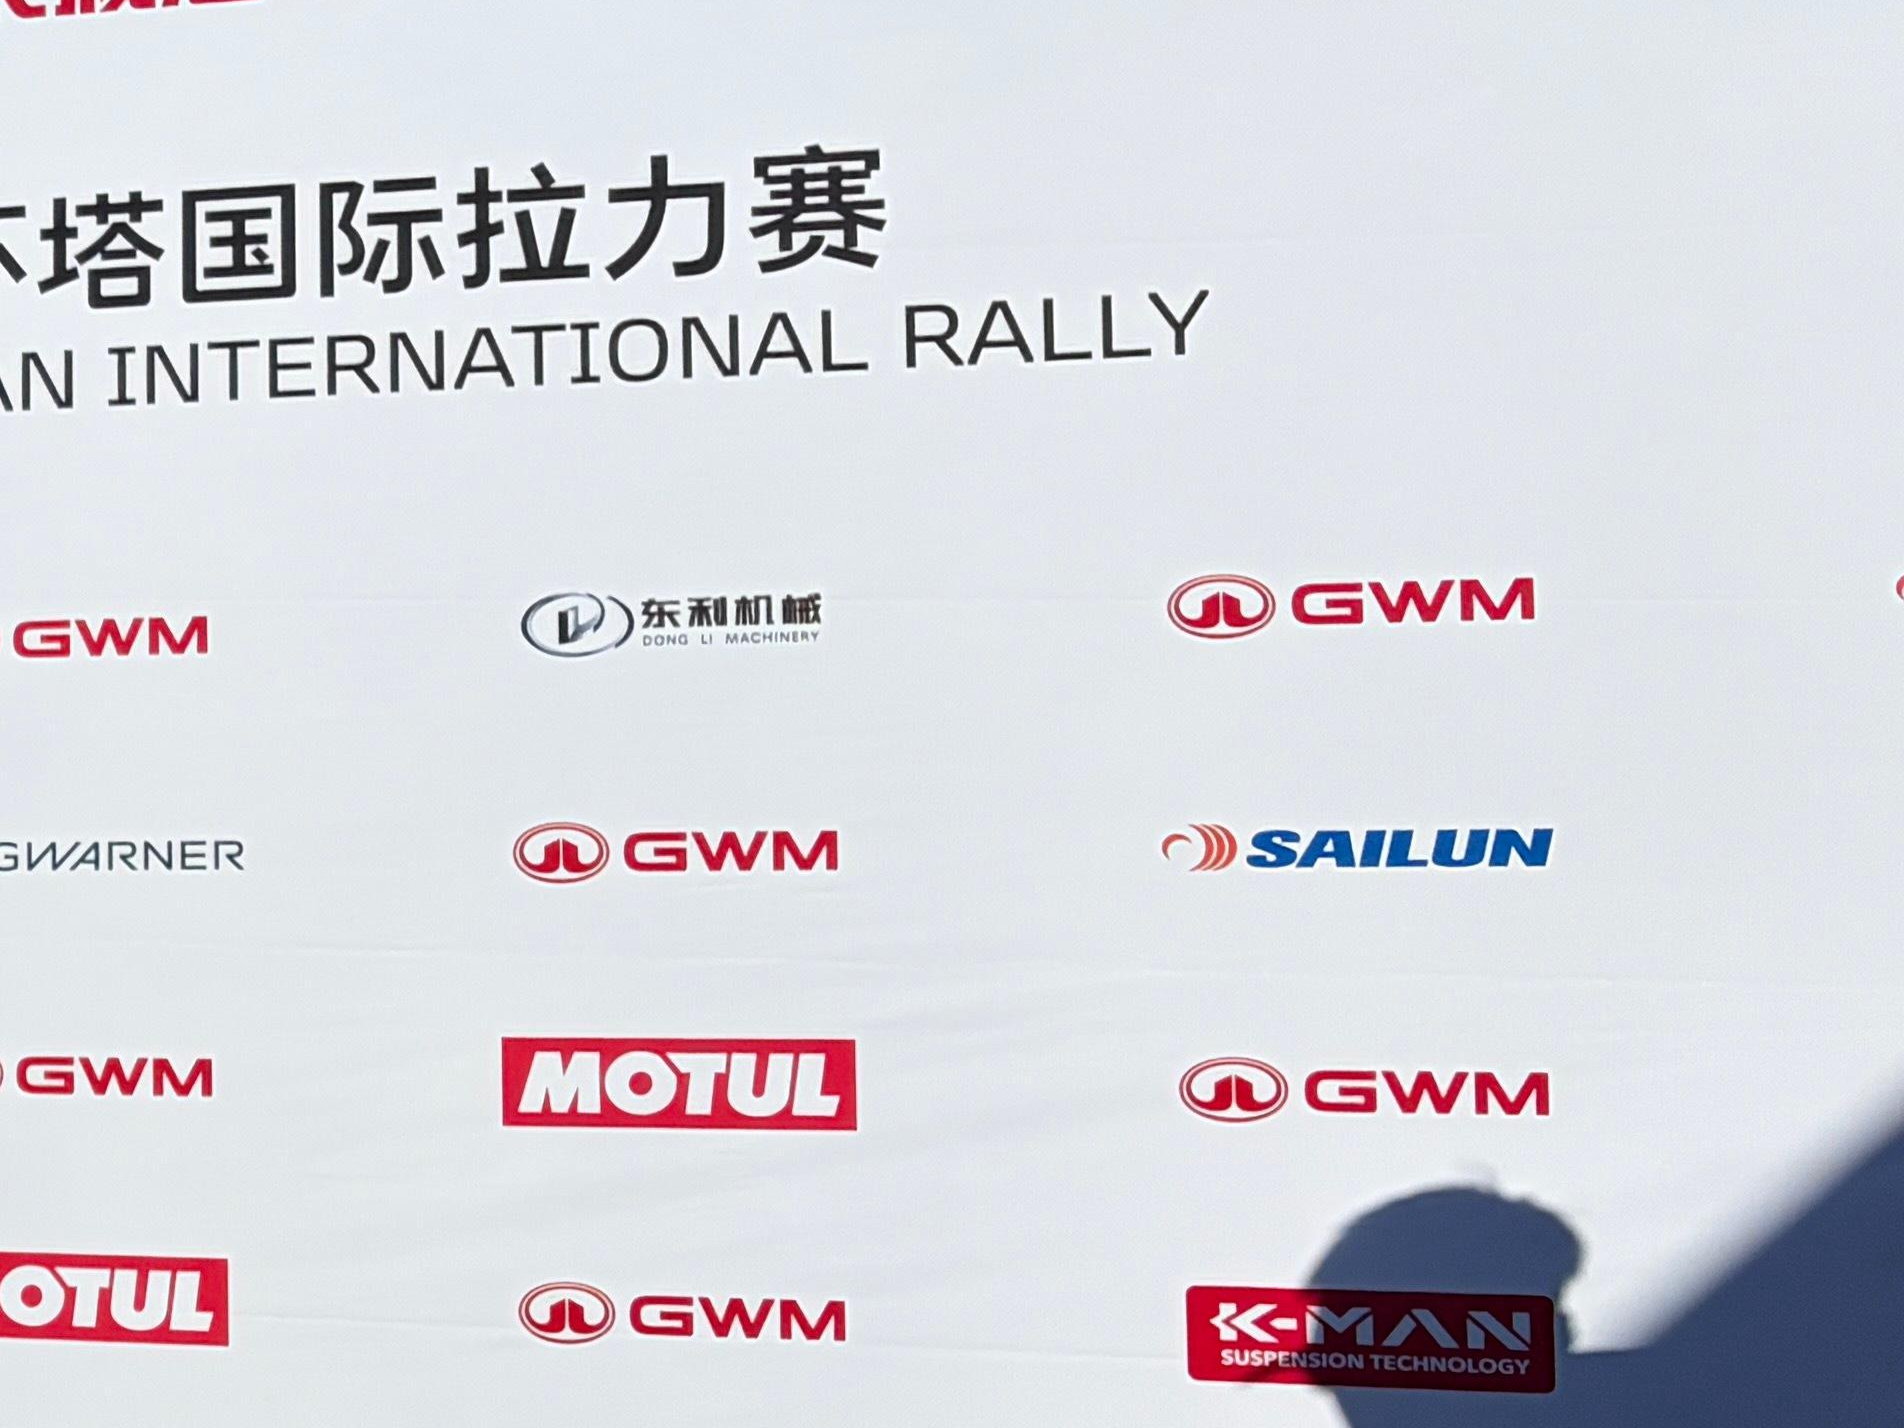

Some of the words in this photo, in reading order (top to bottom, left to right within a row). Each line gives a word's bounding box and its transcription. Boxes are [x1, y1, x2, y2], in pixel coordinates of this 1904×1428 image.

[107, 308, 870, 407] INTERNATIONAL
[905, 289, 1210, 369] RALLY
[641, 592, 822, 629] 东利机械
[1291, 577, 1535, 625] GWM
[13, 615, 208, 658] GWM
[642, 633, 689, 647] DONG
[700, 633, 713, 645] LI
[725, 630, 819, 645] MACHINERY
[623, 830, 838, 872] GWM
[1246, 828, 1554, 869] SAILUN
[16, 1056, 213, 1097] GWM
[517, 1050, 841, 1118] MOTUL
[1304, 1070, 1550, 1116] GWM
[629, 1295, 846, 1342] GWM
[1210, 1301, 1531, 1351] K-MAN
[1221, 1348, 1364, 1370] SUSPENSION
[1369, 1353, 1530, 1375] TECHNOLOGY
